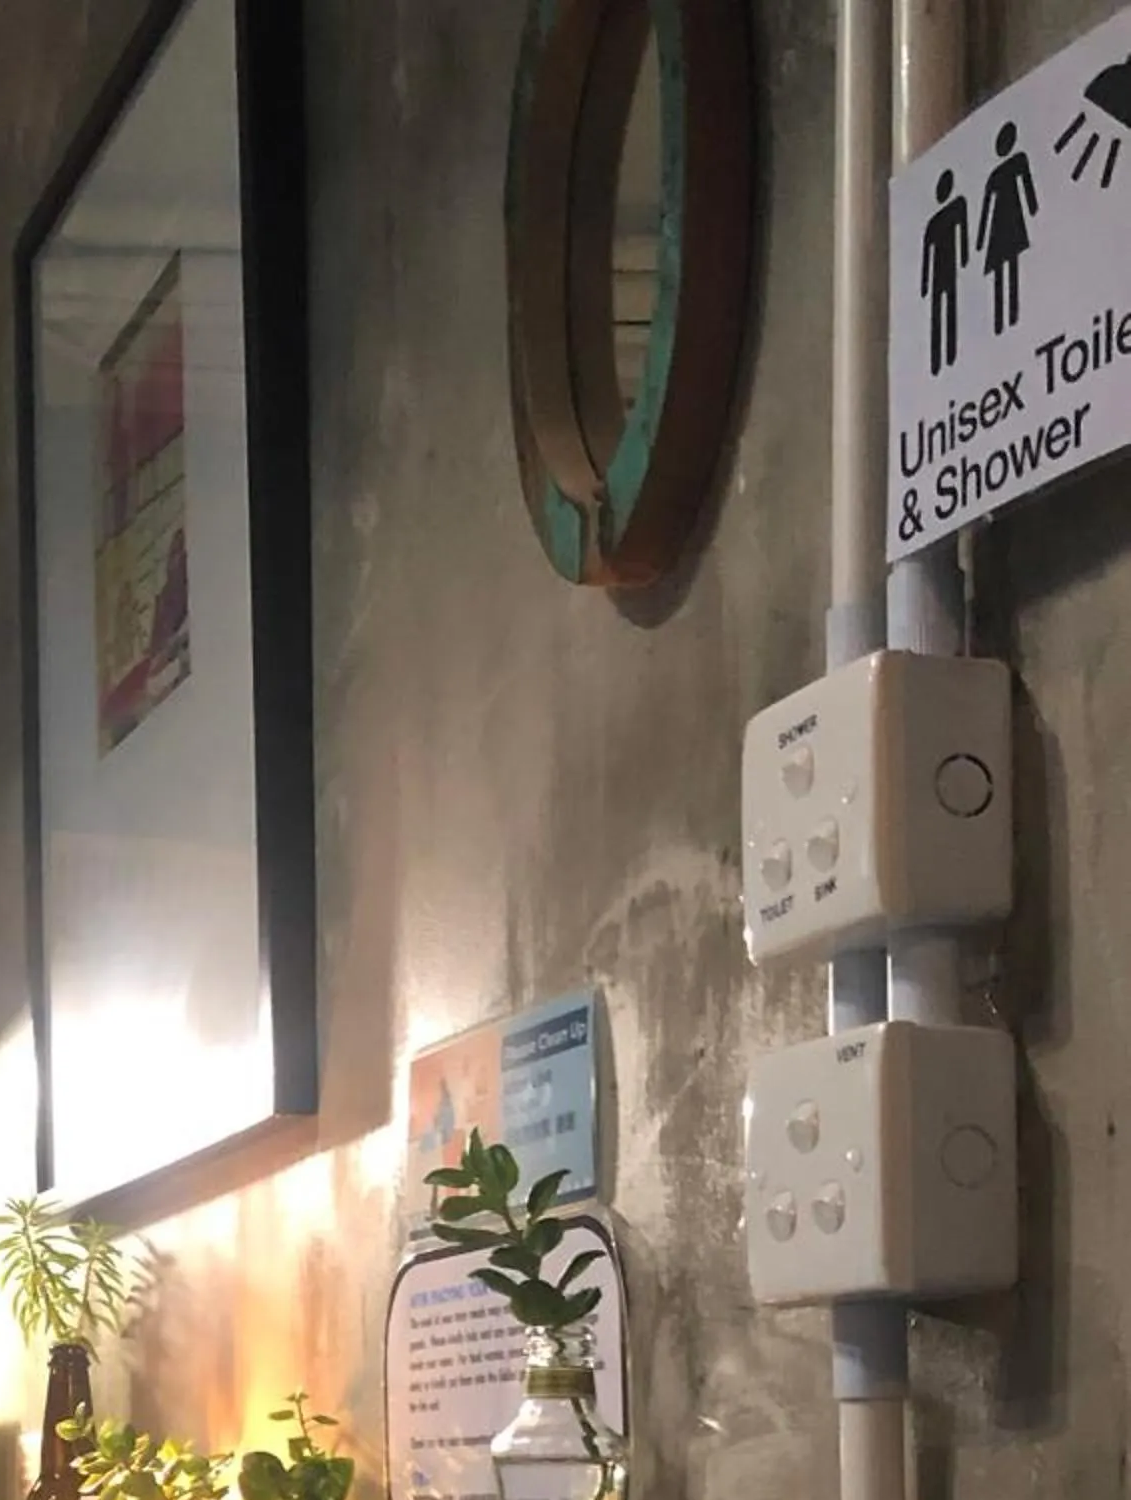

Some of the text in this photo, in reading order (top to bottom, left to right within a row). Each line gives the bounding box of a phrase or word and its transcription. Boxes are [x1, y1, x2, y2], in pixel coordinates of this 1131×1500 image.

[898, 402, 1091, 541] & Shower
[900, 371, 1025, 479] Unisex
[778, 713, 818, 750] SHOWER
